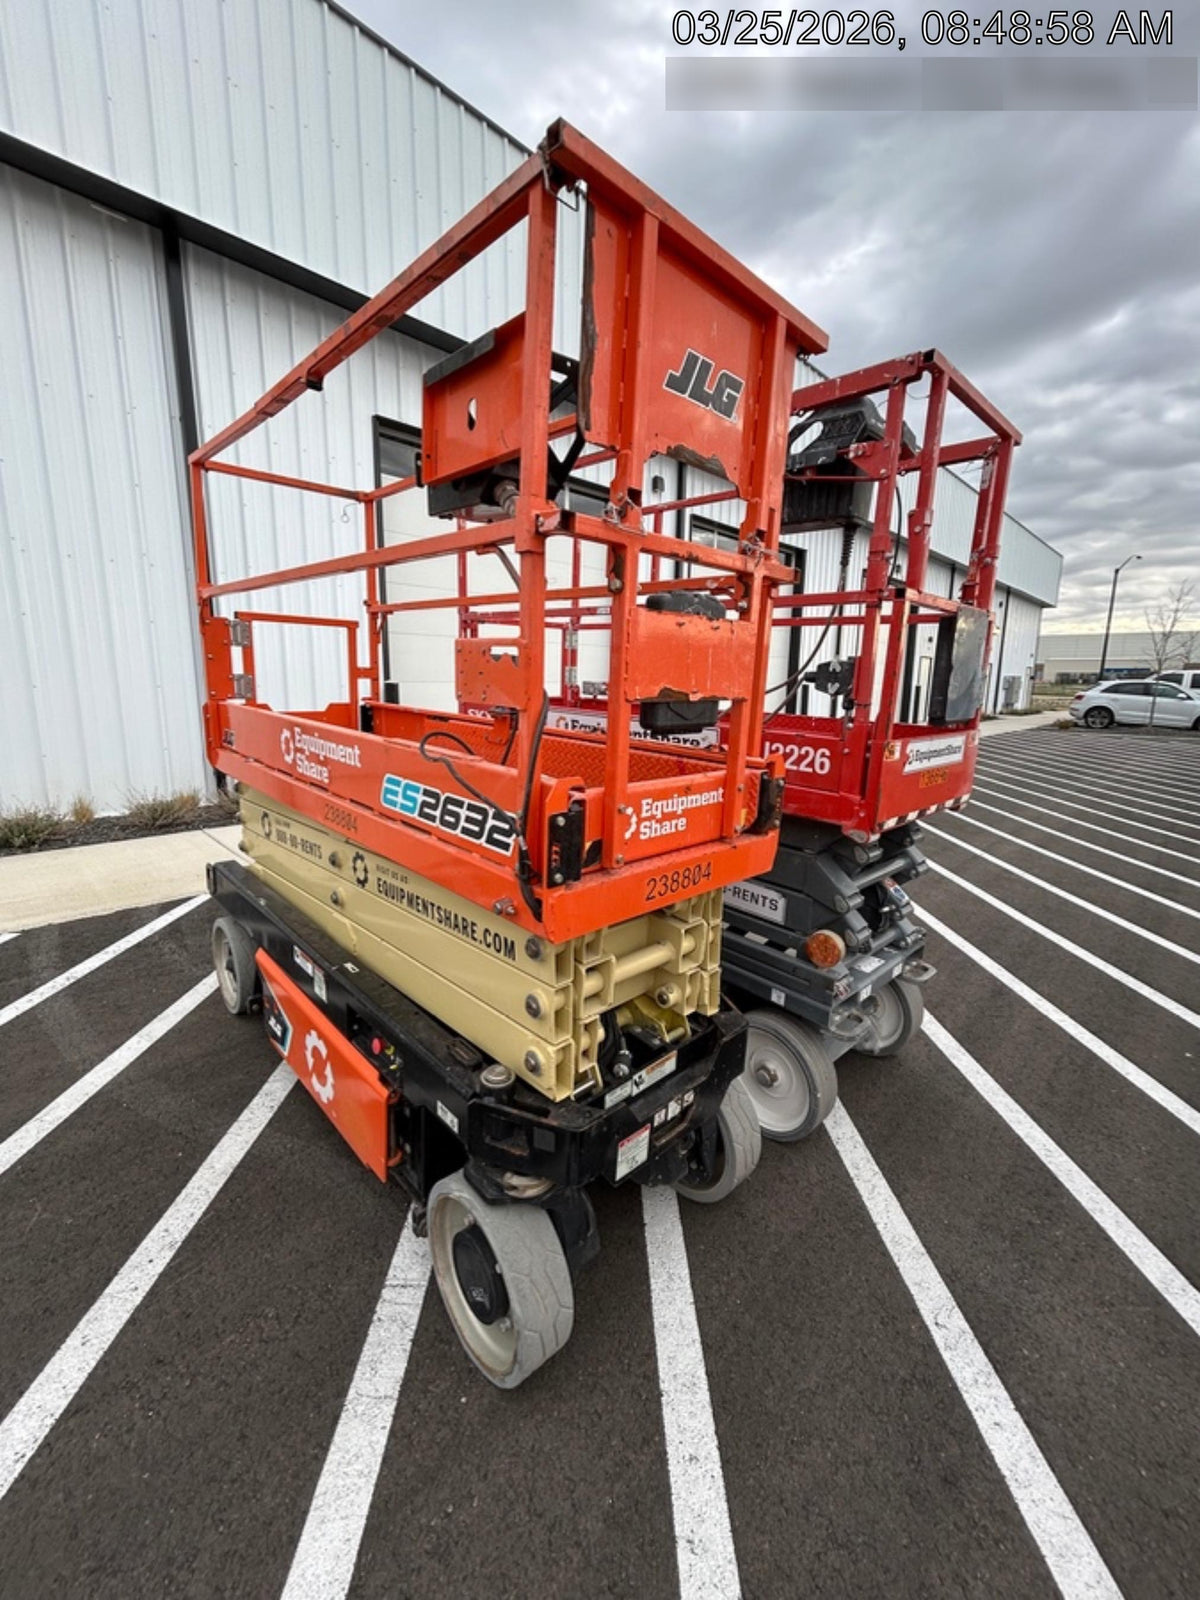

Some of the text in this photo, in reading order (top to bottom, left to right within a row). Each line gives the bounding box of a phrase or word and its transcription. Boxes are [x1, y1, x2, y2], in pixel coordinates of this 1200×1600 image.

[663, 348, 744, 422] JLG
[294, 726, 361, 768] Equipment
[296, 753, 330, 784] Share
[324, 803, 358, 834] 238804
[381, 774, 518, 857] ES2632
[641, 787, 724, 819] Equipment
[639, 817, 687, 840] Share
[645, 862, 712, 901] 238804
[723, 886, 779, 911] -RENTS
[377, 877, 516, 962] EQUIPMENTSHARE.COM
